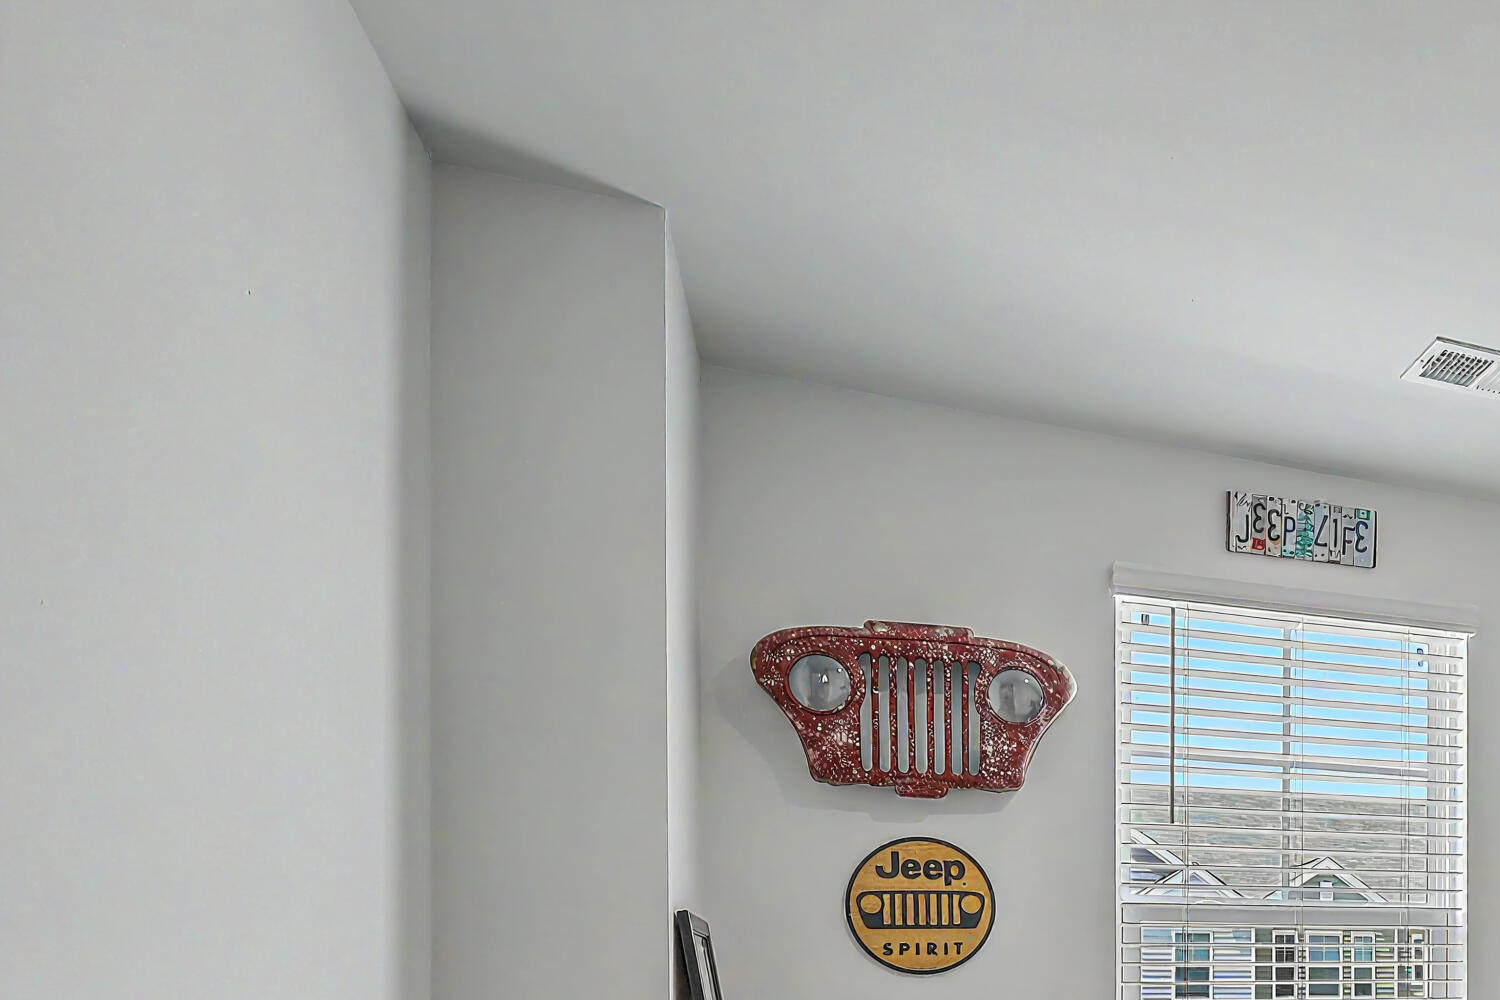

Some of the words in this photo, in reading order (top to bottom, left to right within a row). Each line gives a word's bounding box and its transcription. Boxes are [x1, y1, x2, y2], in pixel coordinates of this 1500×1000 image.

[1235, 502, 1296, 547] JEEP
[1314, 514, 1369, 556] LIFE
[875, 851, 966, 886] Jeep
[882, 942, 963, 956] SPIRIT
